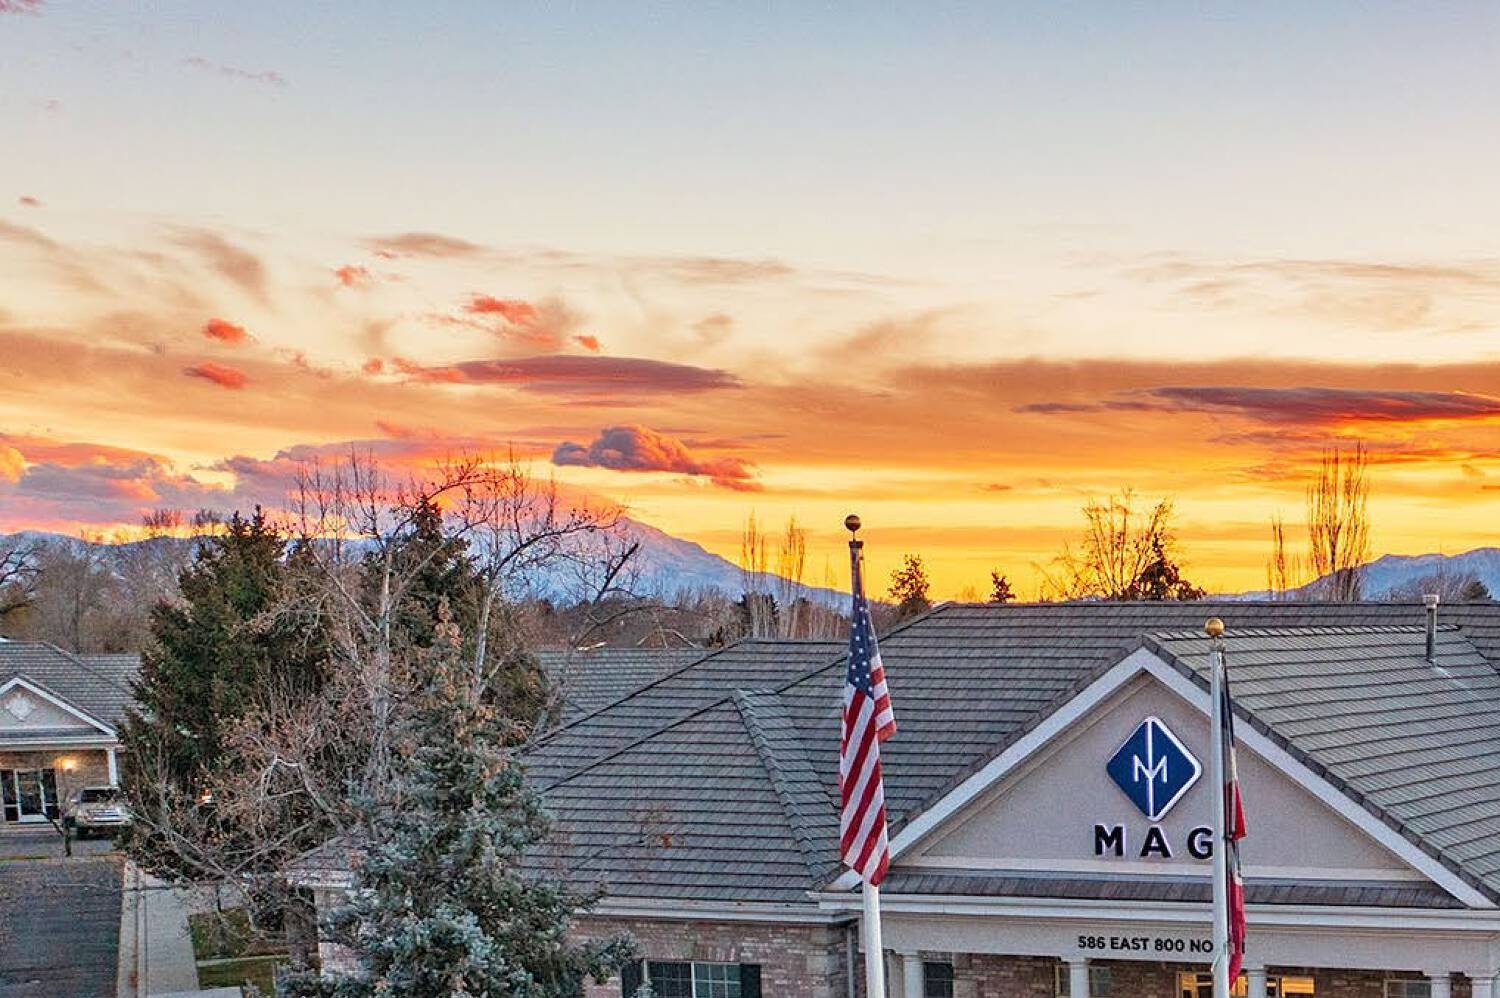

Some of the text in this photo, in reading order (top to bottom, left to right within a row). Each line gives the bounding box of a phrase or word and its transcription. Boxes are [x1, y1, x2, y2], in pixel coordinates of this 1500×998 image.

[1094, 824, 1214, 860] MAG
[1077, 935, 1106, 950] 586
[1110, 936, 1149, 951] EAST
[1154, 938, 1185, 952] 800
